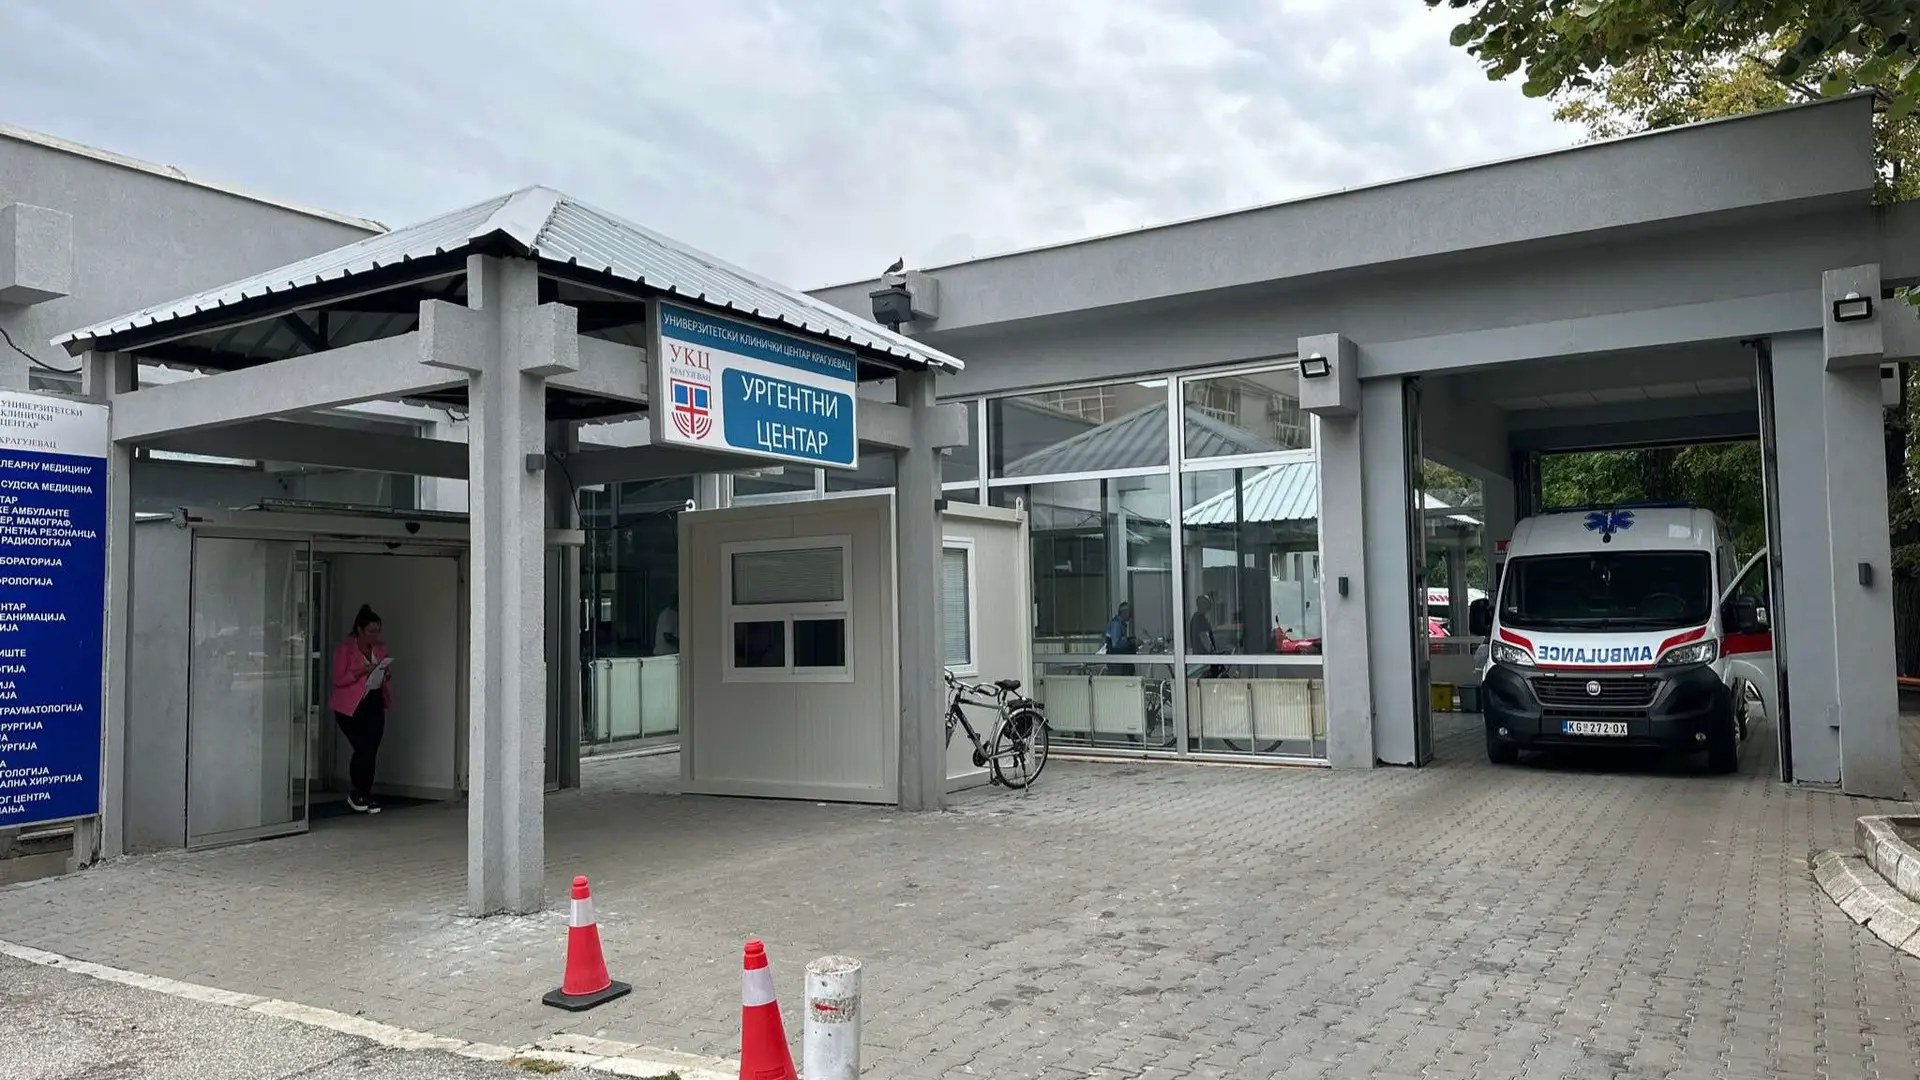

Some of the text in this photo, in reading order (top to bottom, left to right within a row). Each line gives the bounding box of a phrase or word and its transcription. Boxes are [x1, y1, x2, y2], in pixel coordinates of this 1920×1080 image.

[663, 312, 851, 373] УНИВЕРЗИТЕТСКИ КЛИНИЧКИ ЦЕНТАР КРАГУЈЕВАЦ
[669, 343, 711, 374] УКЦ
[669, 366, 711, 382] КРАГУЈЕВАЦ
[741, 375, 838, 419] УРГЕНТНИ
[1, 400, 83, 416] УНИВЕРЗИТЕТСКИ
[0, 409, 53, 422] КЛИНИЧКИ
[0, 419, 39, 429] ЦЕНТАР
[757, 419, 829, 454] ЦЕНТАР
[0, 436, 57, 449] КРАГУЈЕВАЦ
[42, 463, 92, 475] МЕДИЦИНУ
[1, 480, 93, 494] СУДСКА МЕДИЦИНА
[11, 507, 70, 518] АМБУЛАНТЕ
[17, 517, 73, 528] МАМОГРАФ,
[40, 528, 97, 538] РЕЗОНАНЦА
[1, 536, 72, 547] РАДИОЛОГИЈА
[0, 577, 53, 586] РОЛОГИЈА
[0, 665, 26, 673] ГИЈА
[0, 742, 37, 752] УРГИЈА
[29, 774, 83, 785] ХИРУРГИЈА
[13, 792, 51, 803] ЦЕНТРА
[0, 805, 25, 814] АЊА
